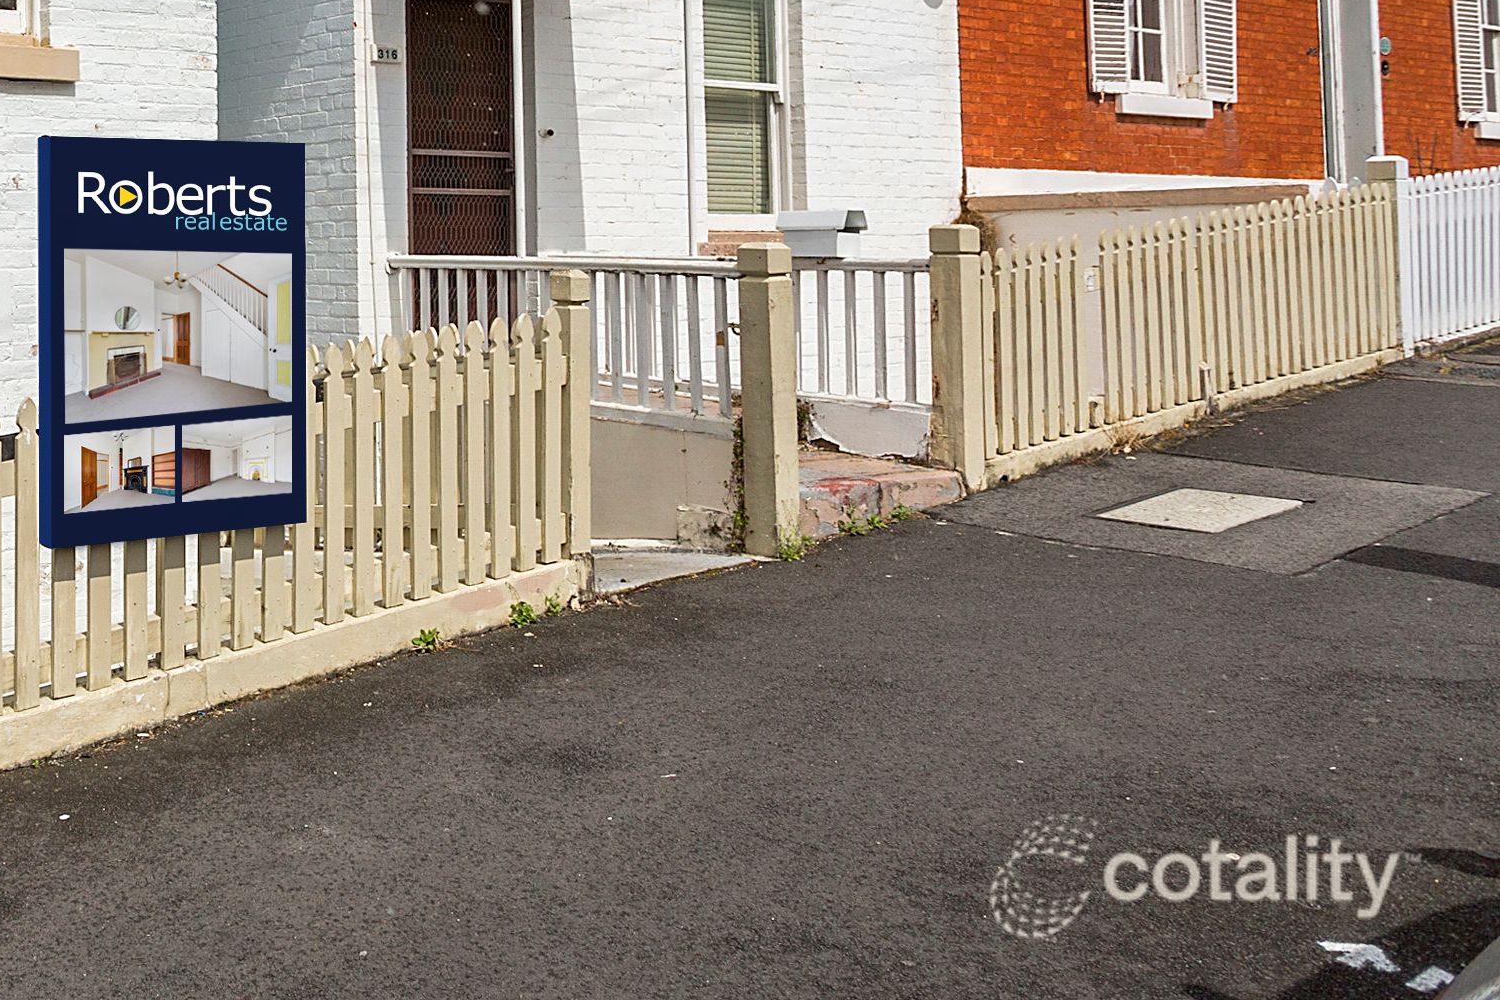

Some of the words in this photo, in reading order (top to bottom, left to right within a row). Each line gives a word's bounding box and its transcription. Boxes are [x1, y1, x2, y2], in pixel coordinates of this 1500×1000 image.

[377, 49, 398, 60] 316
[77, 171, 273, 217] Roberts
[175, 212, 216, 230] real
[220, 213, 288, 232] estate
